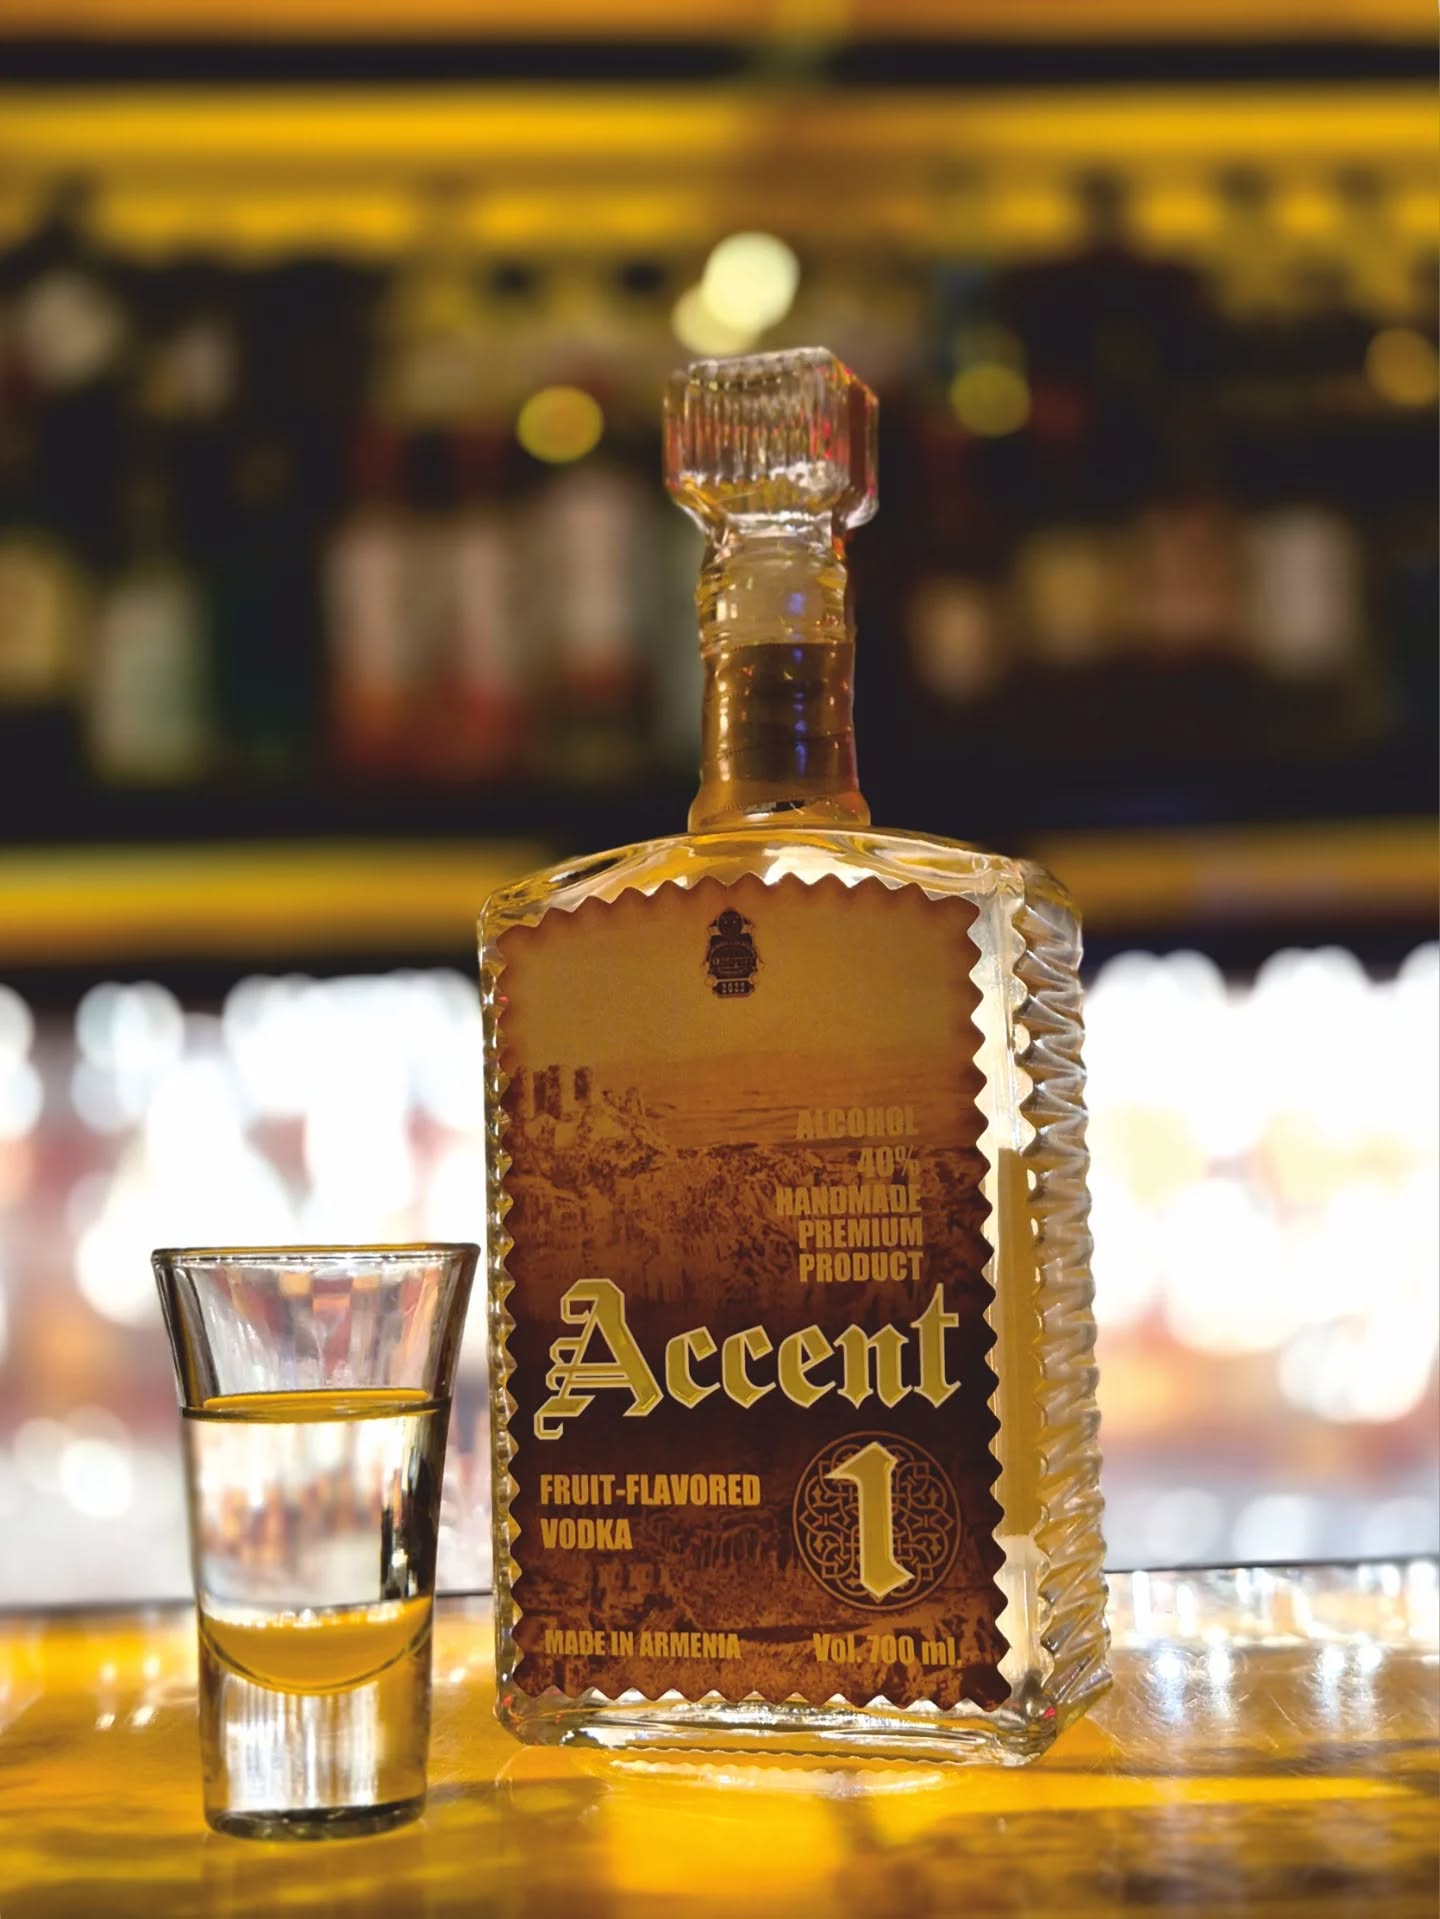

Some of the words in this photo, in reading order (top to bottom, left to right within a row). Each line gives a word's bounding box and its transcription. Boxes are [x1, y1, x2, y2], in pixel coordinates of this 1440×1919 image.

[796, 1105, 919, 1140] ALCOHOL
[857, 1145, 920, 1178] 40%
[776, 1184, 922, 1216] HANDMADE
[799, 1217, 923, 1248] PREMIUM
[800, 1252, 923, 1282] PRODUCT
[533, 1278, 962, 1440] Accent
[540, 1474, 761, 1506] FRUIT-FLAVORED
[540, 1518, 633, 1550] VODKA
[825, 1441, 915, 1600] 1
[545, 1629, 606, 1656] MADE
[611, 1631, 634, 1656] IN
[639, 1632, 742, 1658] ARMENIA
[813, 1632, 862, 1664] Vol.
[867, 1634, 915, 1664] 700
[922, 1636, 961, 1665] ml.
